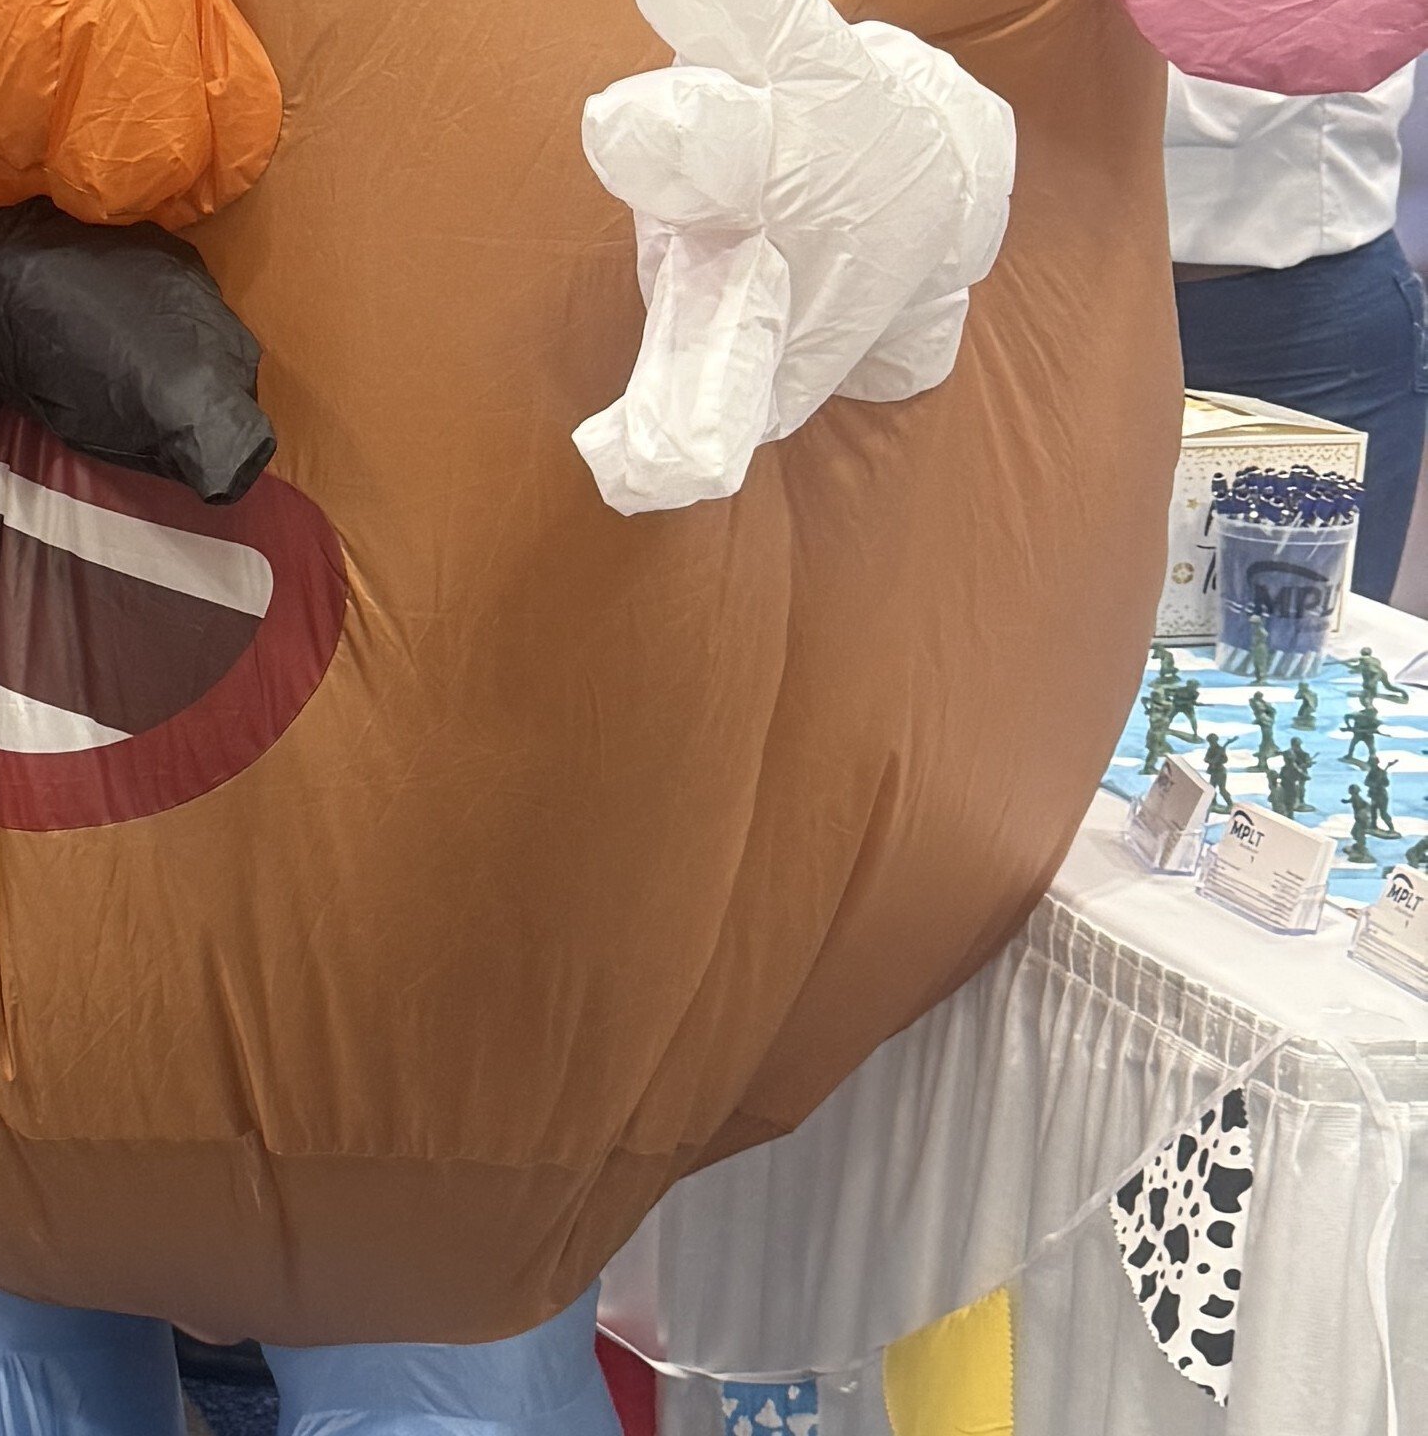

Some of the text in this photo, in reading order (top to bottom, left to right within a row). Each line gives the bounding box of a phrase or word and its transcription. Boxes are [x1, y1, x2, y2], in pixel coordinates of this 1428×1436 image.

[1254, 583, 1344, 619] MPL
[1230, 820, 1265, 847] MPLT
[1386, 883, 1425, 912] MPLT
